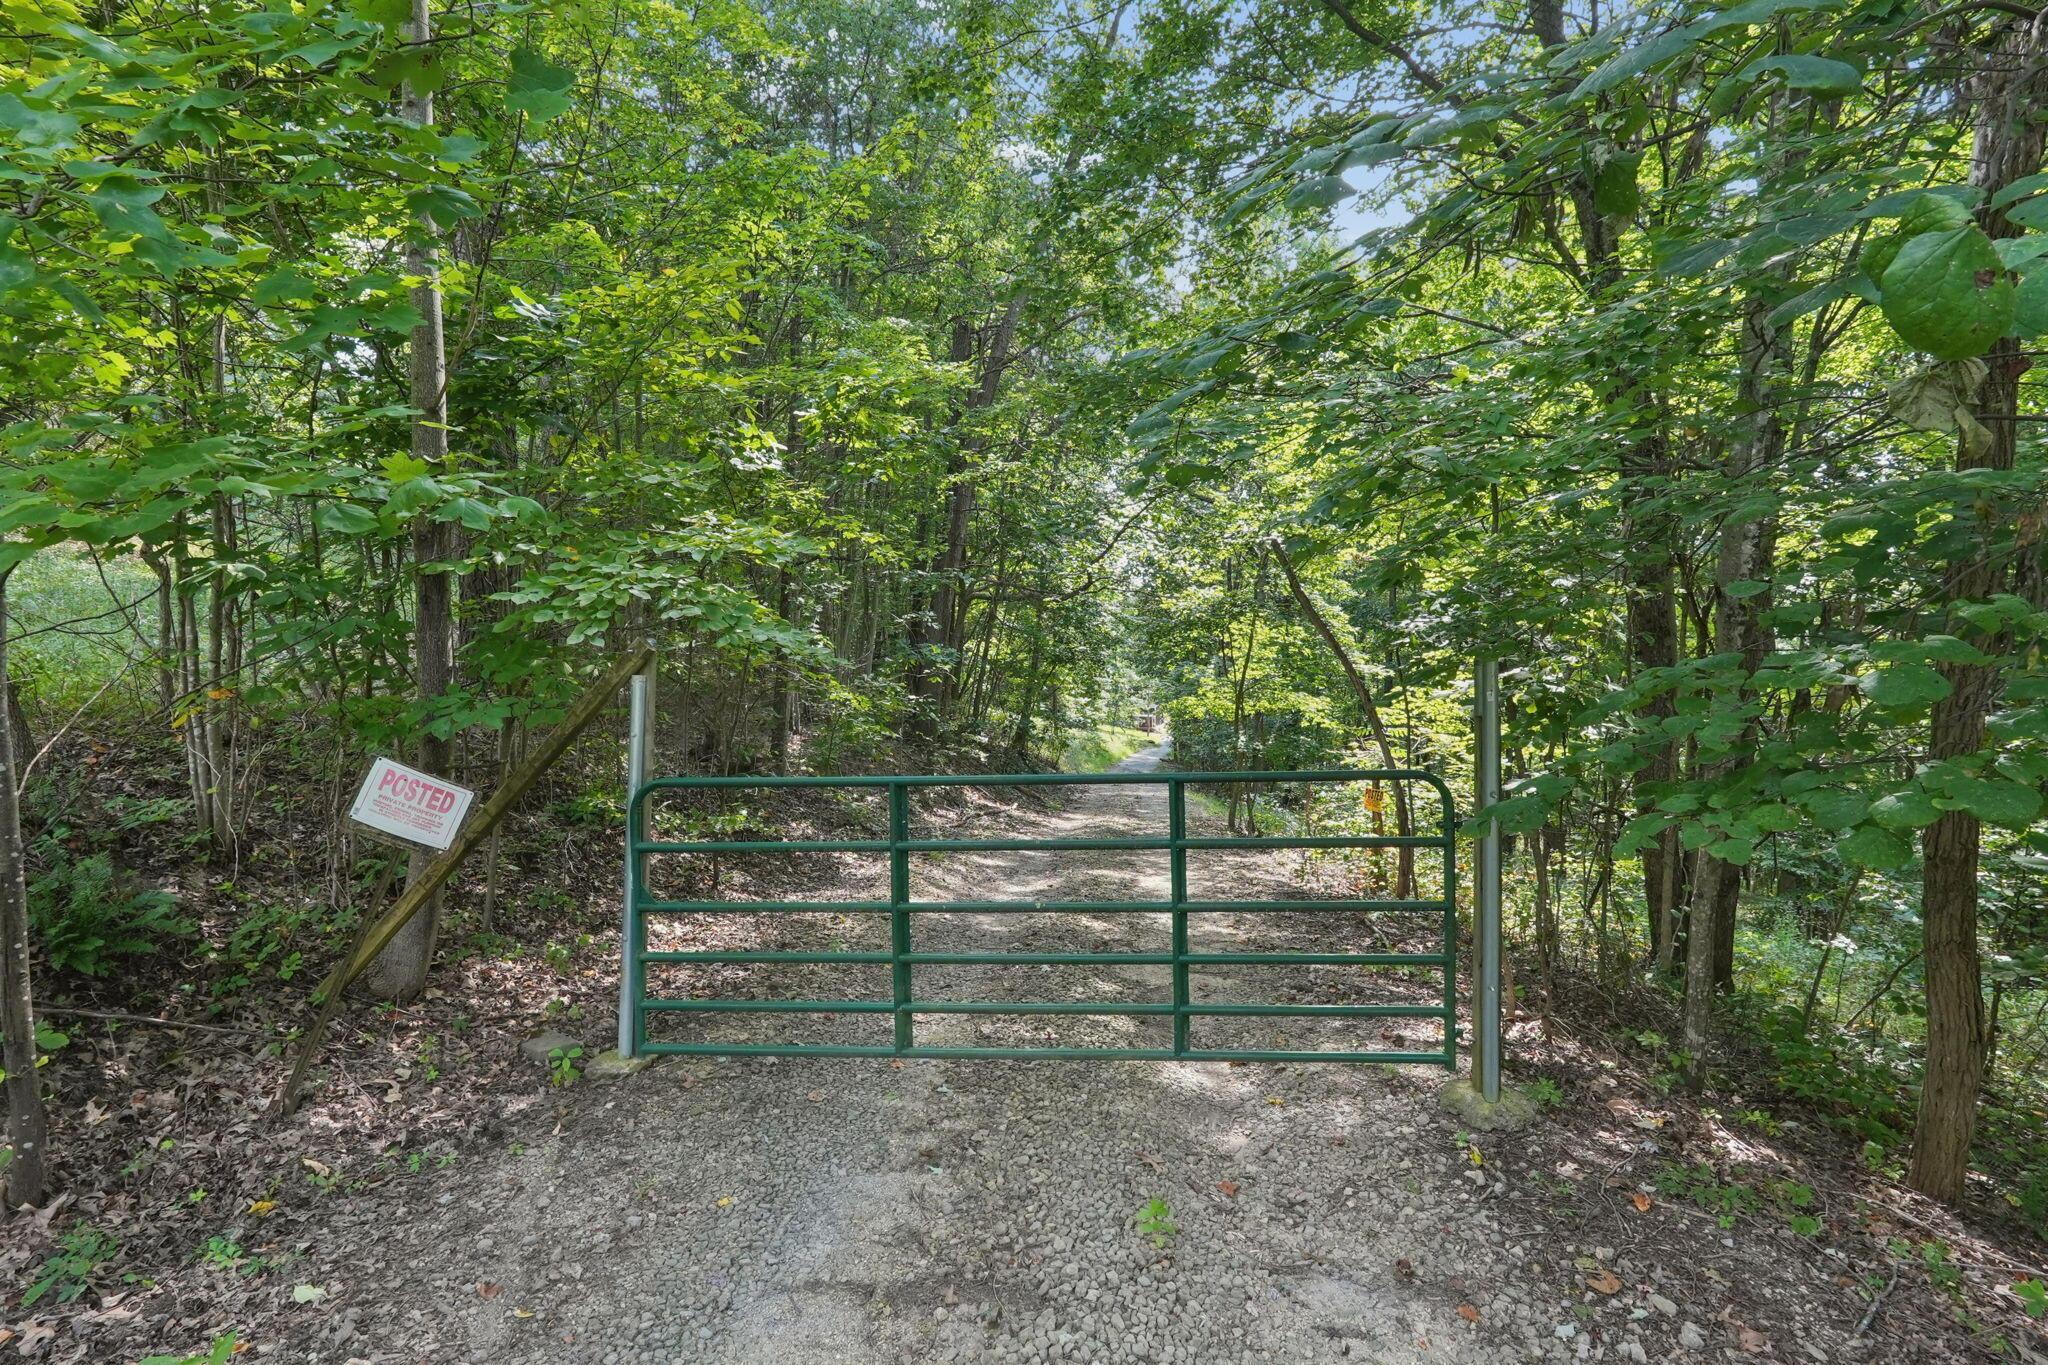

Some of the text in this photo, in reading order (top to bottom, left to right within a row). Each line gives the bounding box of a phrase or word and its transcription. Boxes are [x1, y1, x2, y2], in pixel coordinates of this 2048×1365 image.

[378, 768, 456, 814] POSTED
[1365, 788, 1384, 801] POSTED
[378, 794, 406, 808] PRIVATE
[407, 804, 443, 820] PROPERTY
